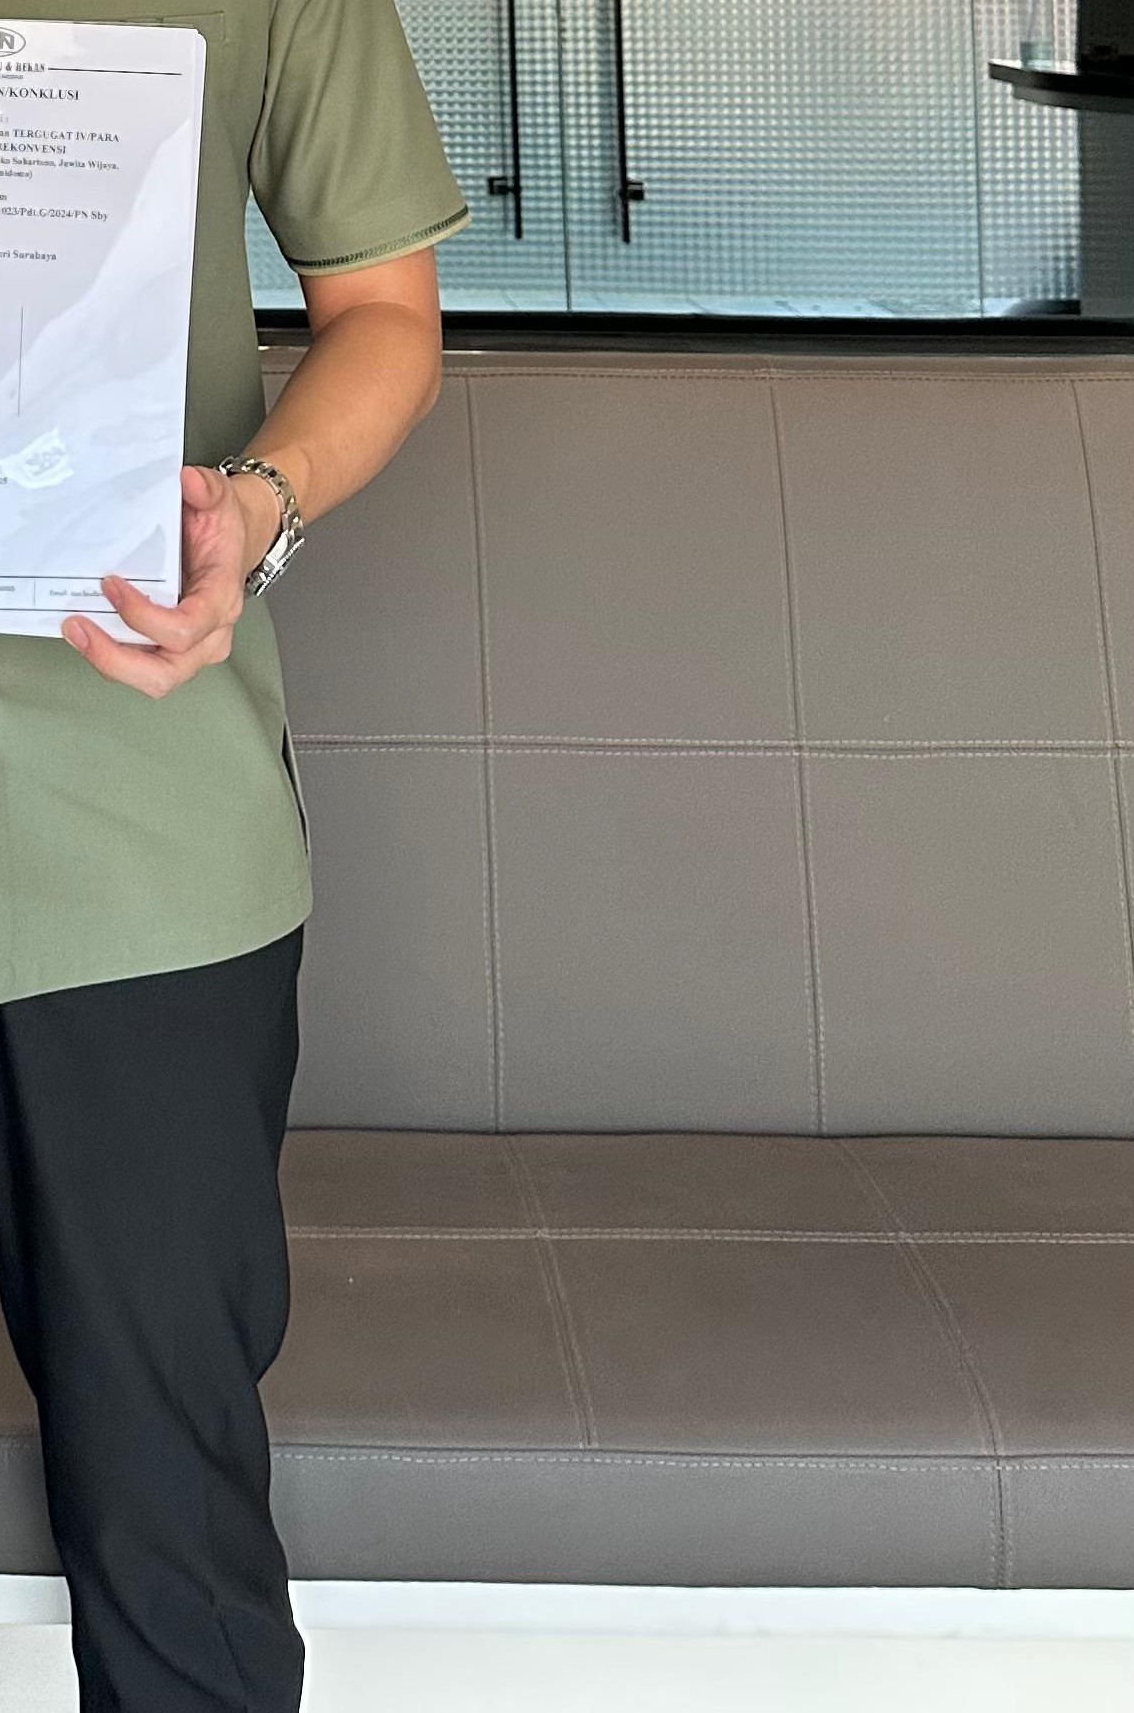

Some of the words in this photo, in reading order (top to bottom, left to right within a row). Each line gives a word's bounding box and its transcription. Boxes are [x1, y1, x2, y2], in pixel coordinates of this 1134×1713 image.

[5, 62, 12, 71] &
[15, 62, 46, 73] REKAN
[12, 128, 73, 140] TERGUGAT
[75, 131, 120, 143] IV/PARA
[90, 210, 108, 221] Sby
[12, 250, 57, 262] Surabaya
